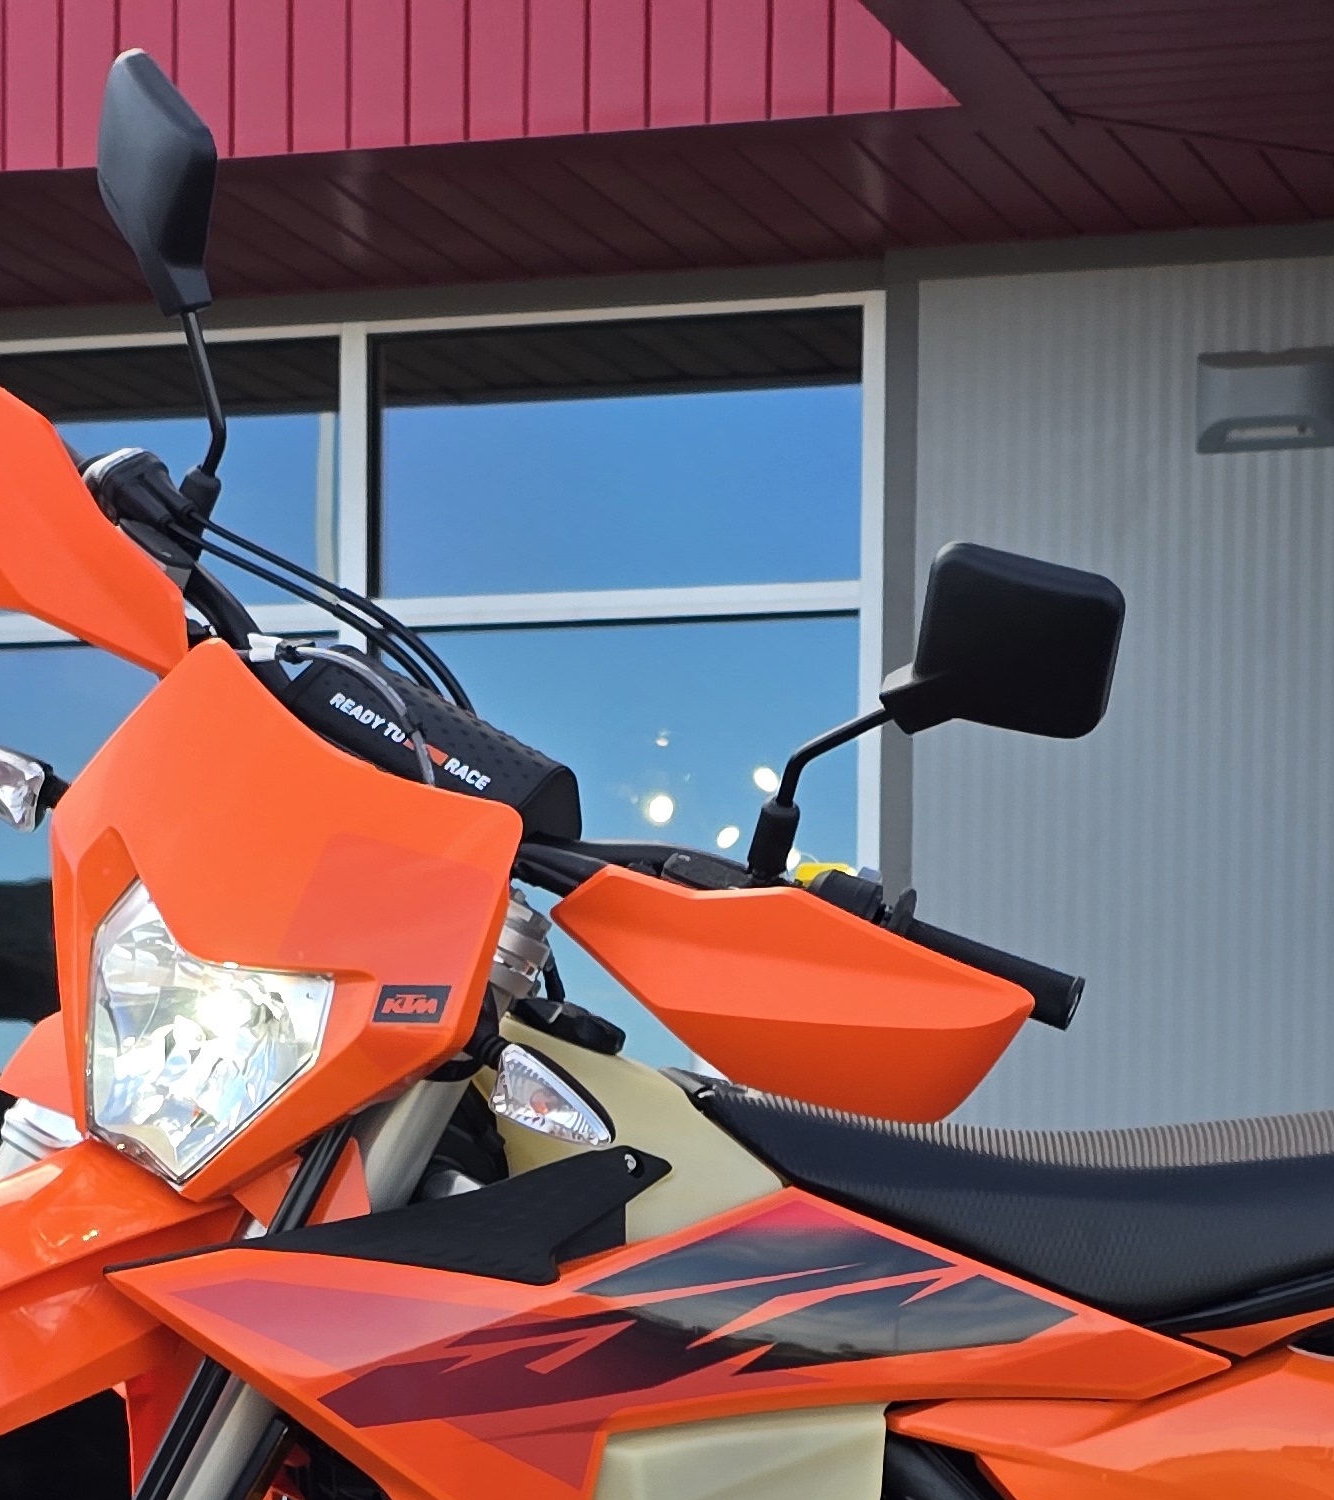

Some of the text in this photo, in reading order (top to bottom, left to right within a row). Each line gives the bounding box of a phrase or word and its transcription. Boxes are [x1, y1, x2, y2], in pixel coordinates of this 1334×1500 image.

[329, 692, 385, 730] READY
[444, 757, 492, 791] RACE
[381, 994, 438, 1014] KTM
